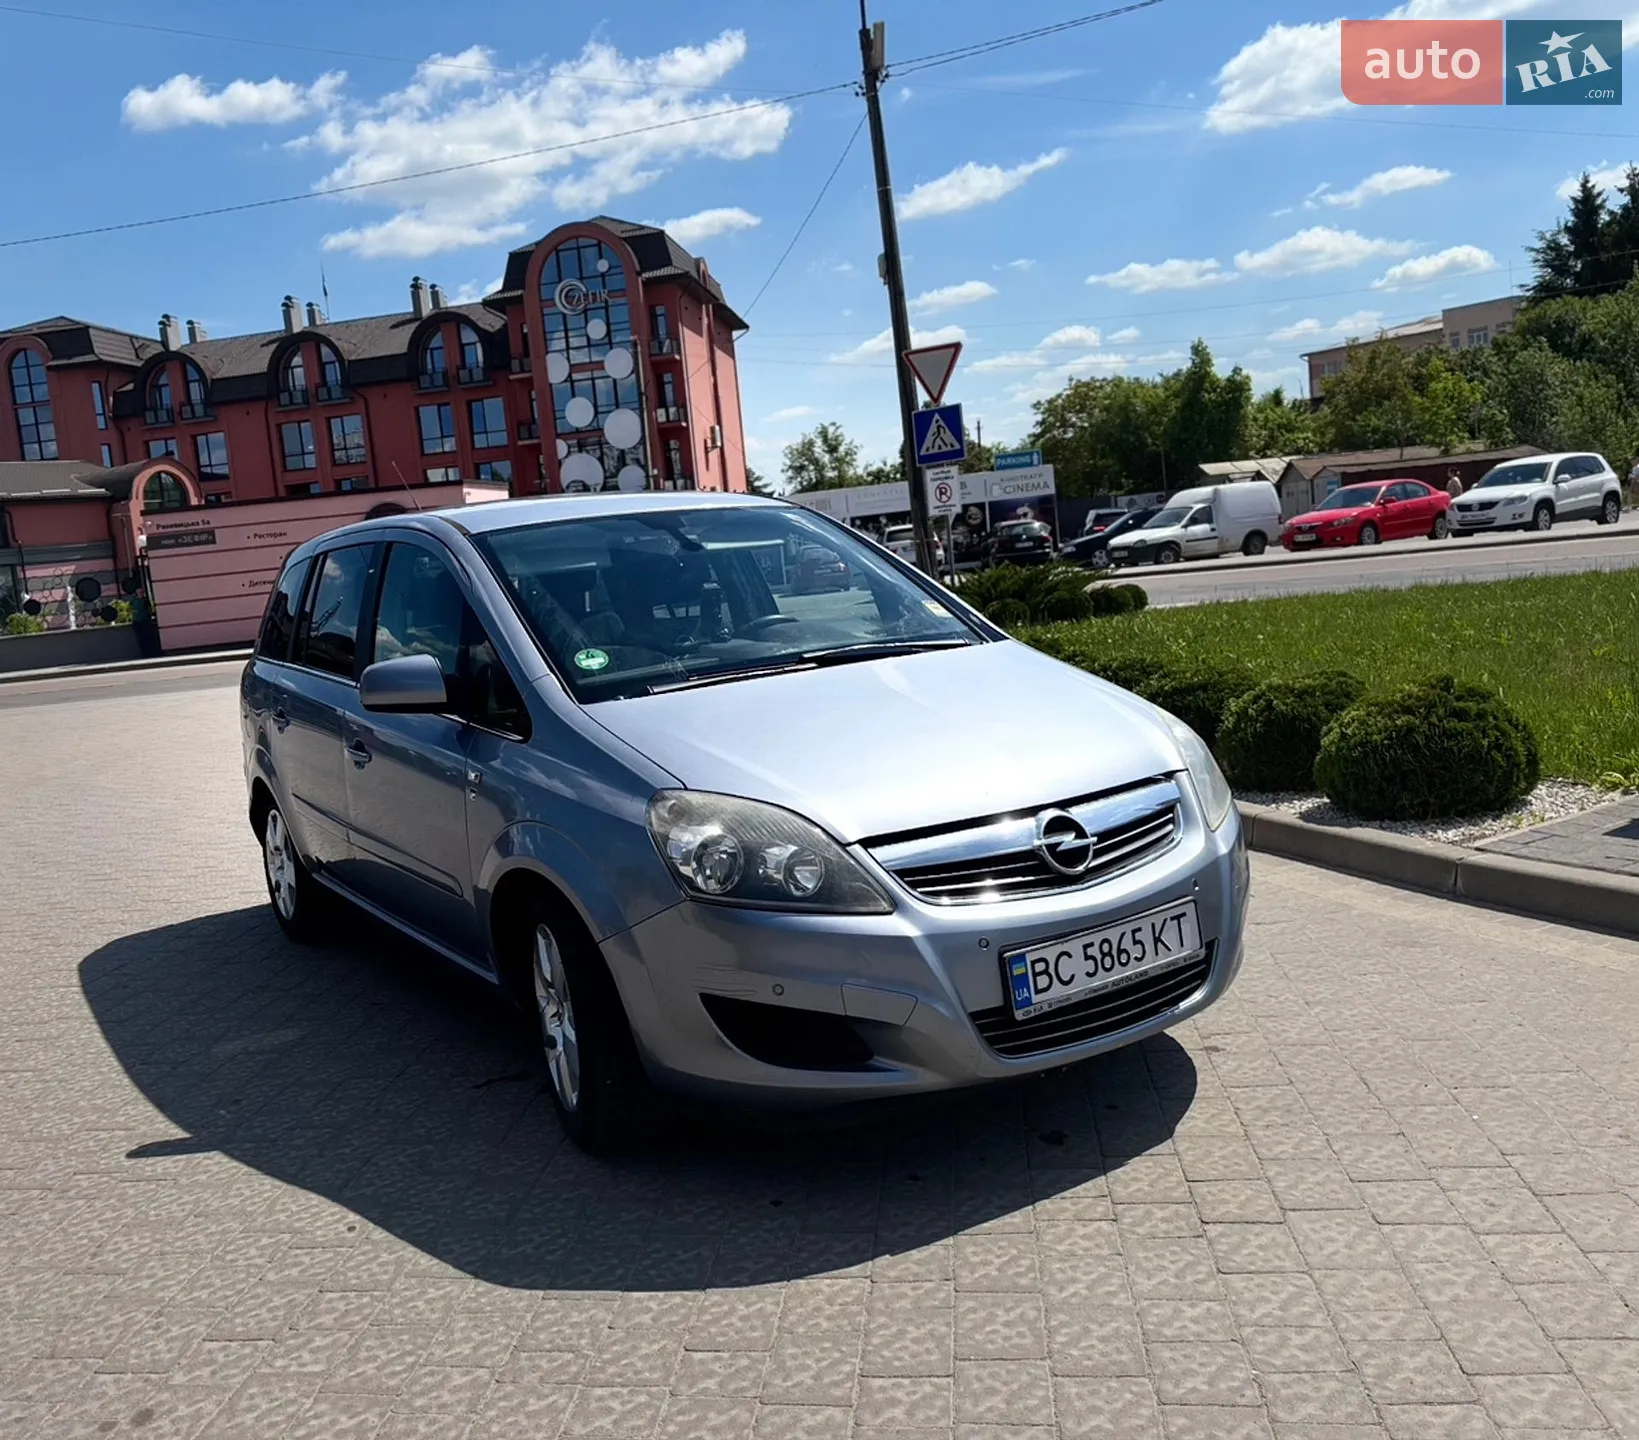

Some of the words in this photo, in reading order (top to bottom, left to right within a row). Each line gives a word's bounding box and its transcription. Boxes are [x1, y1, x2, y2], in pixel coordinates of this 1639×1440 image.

[1003, 480, 1050, 495] CINEMA
[253, 530, 288, 540] Ресторан
[1030, 950, 1076, 996] BC
[1082, 926, 1147, 979] 5865
[1151, 902, 1187, 957] KT
[1015, 987, 1030, 1001] UA
